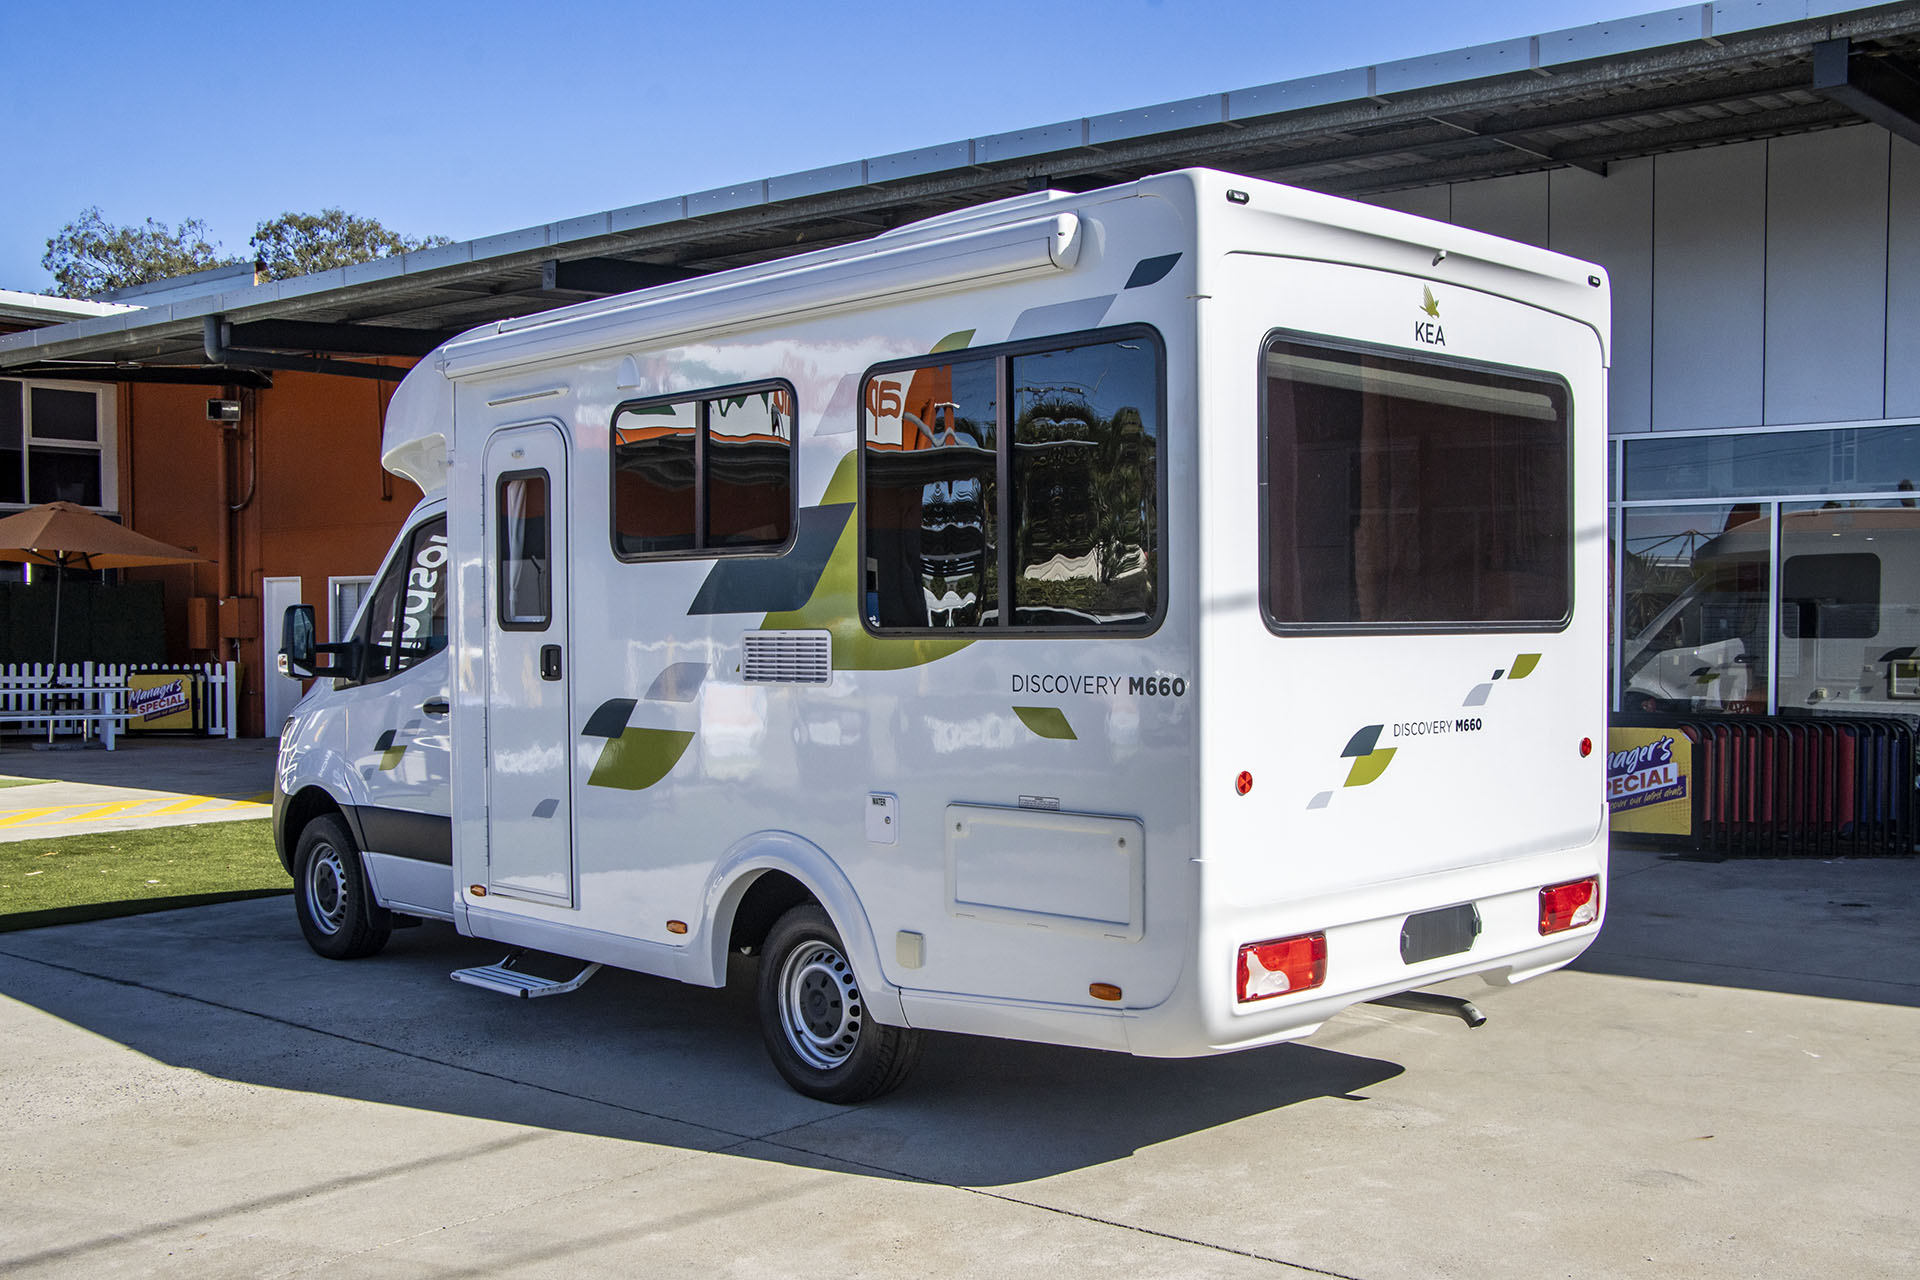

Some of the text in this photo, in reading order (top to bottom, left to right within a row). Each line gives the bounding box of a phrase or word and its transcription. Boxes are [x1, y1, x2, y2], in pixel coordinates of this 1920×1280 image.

[1415, 321, 1446, 346] KEA
[128, 679, 183, 707] Manager's
[1012, 674, 1186, 696] DISCOVERY M660
[138, 695, 184, 714] SPECIAL
[1393, 718, 1483, 737] DISCOVERY M660
[1607, 736, 1674, 774] nager's
[1607, 767, 1674, 795] ECIAL
